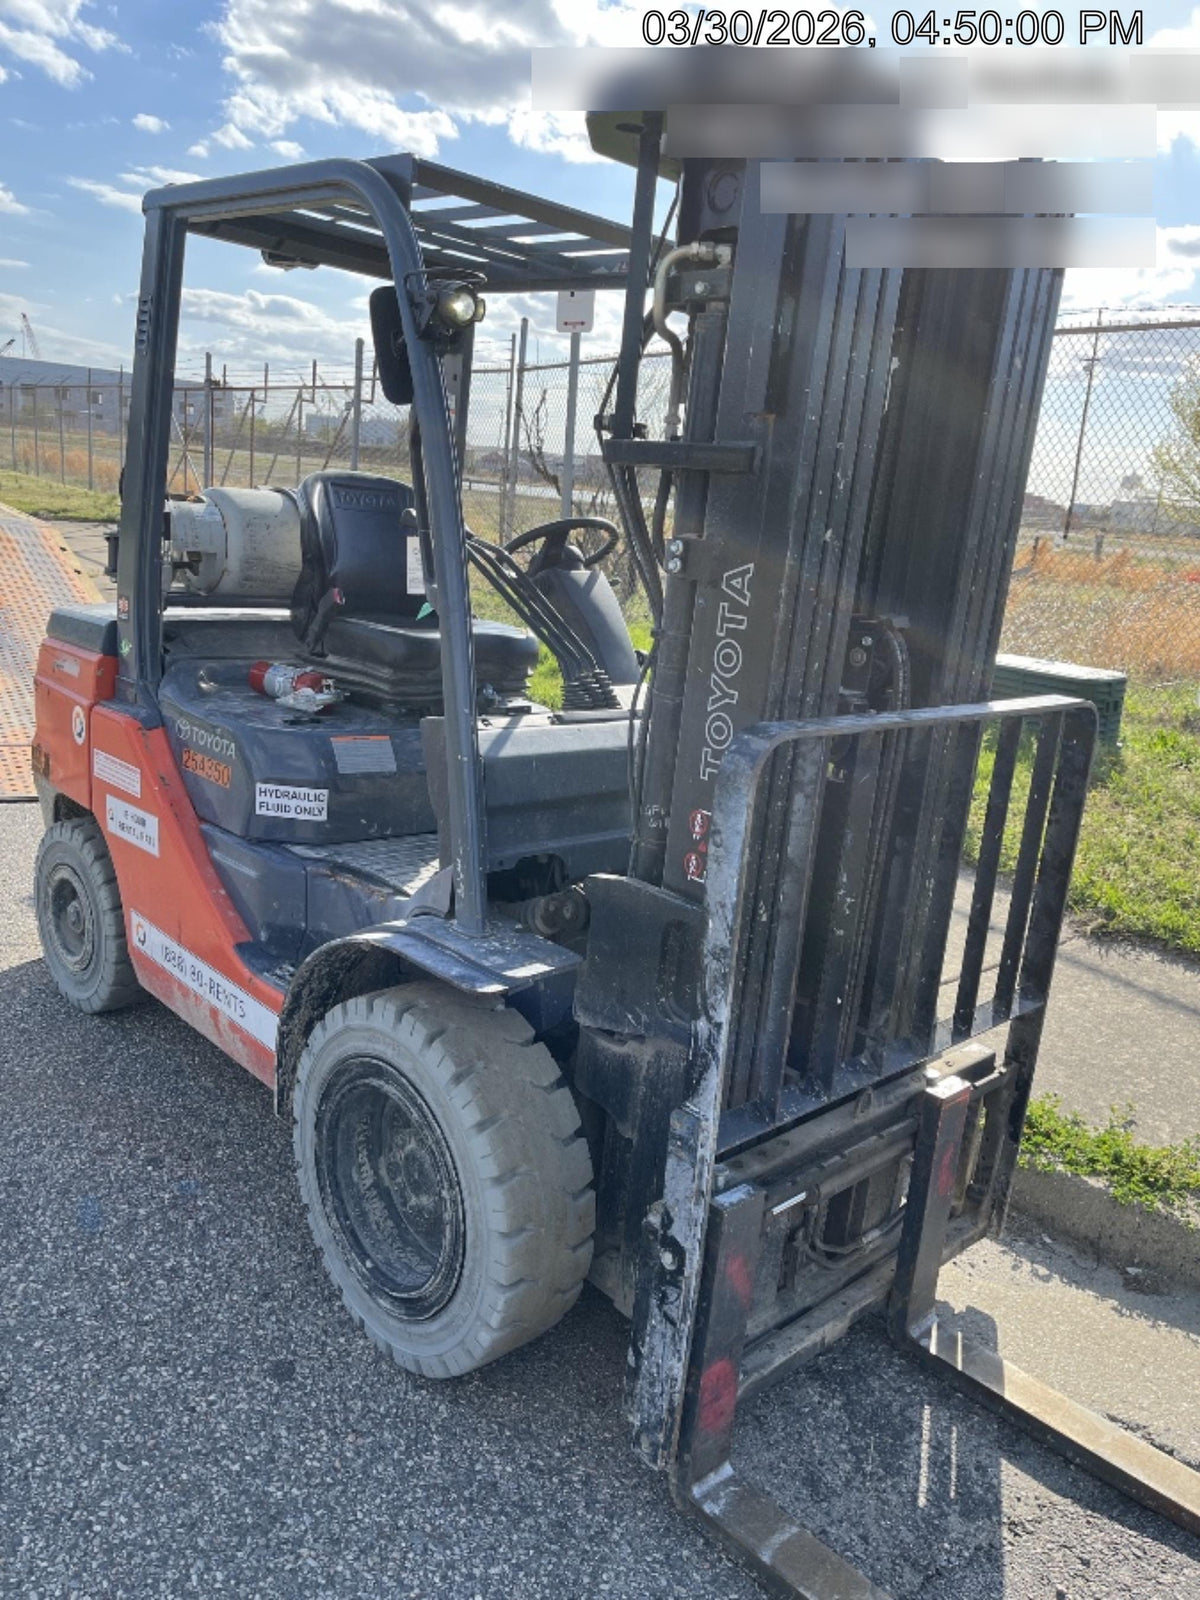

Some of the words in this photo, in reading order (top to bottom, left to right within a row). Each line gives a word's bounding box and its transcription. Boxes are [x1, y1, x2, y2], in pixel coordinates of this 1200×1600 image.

[700, 562, 755, 781] TOYOTA
[192, 726, 237, 760] TOYOTA
[184, 750, 231, 786] 254350
[258, 786, 326, 803] HYDRAULIC
[258, 801, 292, 814] FLUID
[294, 804, 326, 817] ONLY
